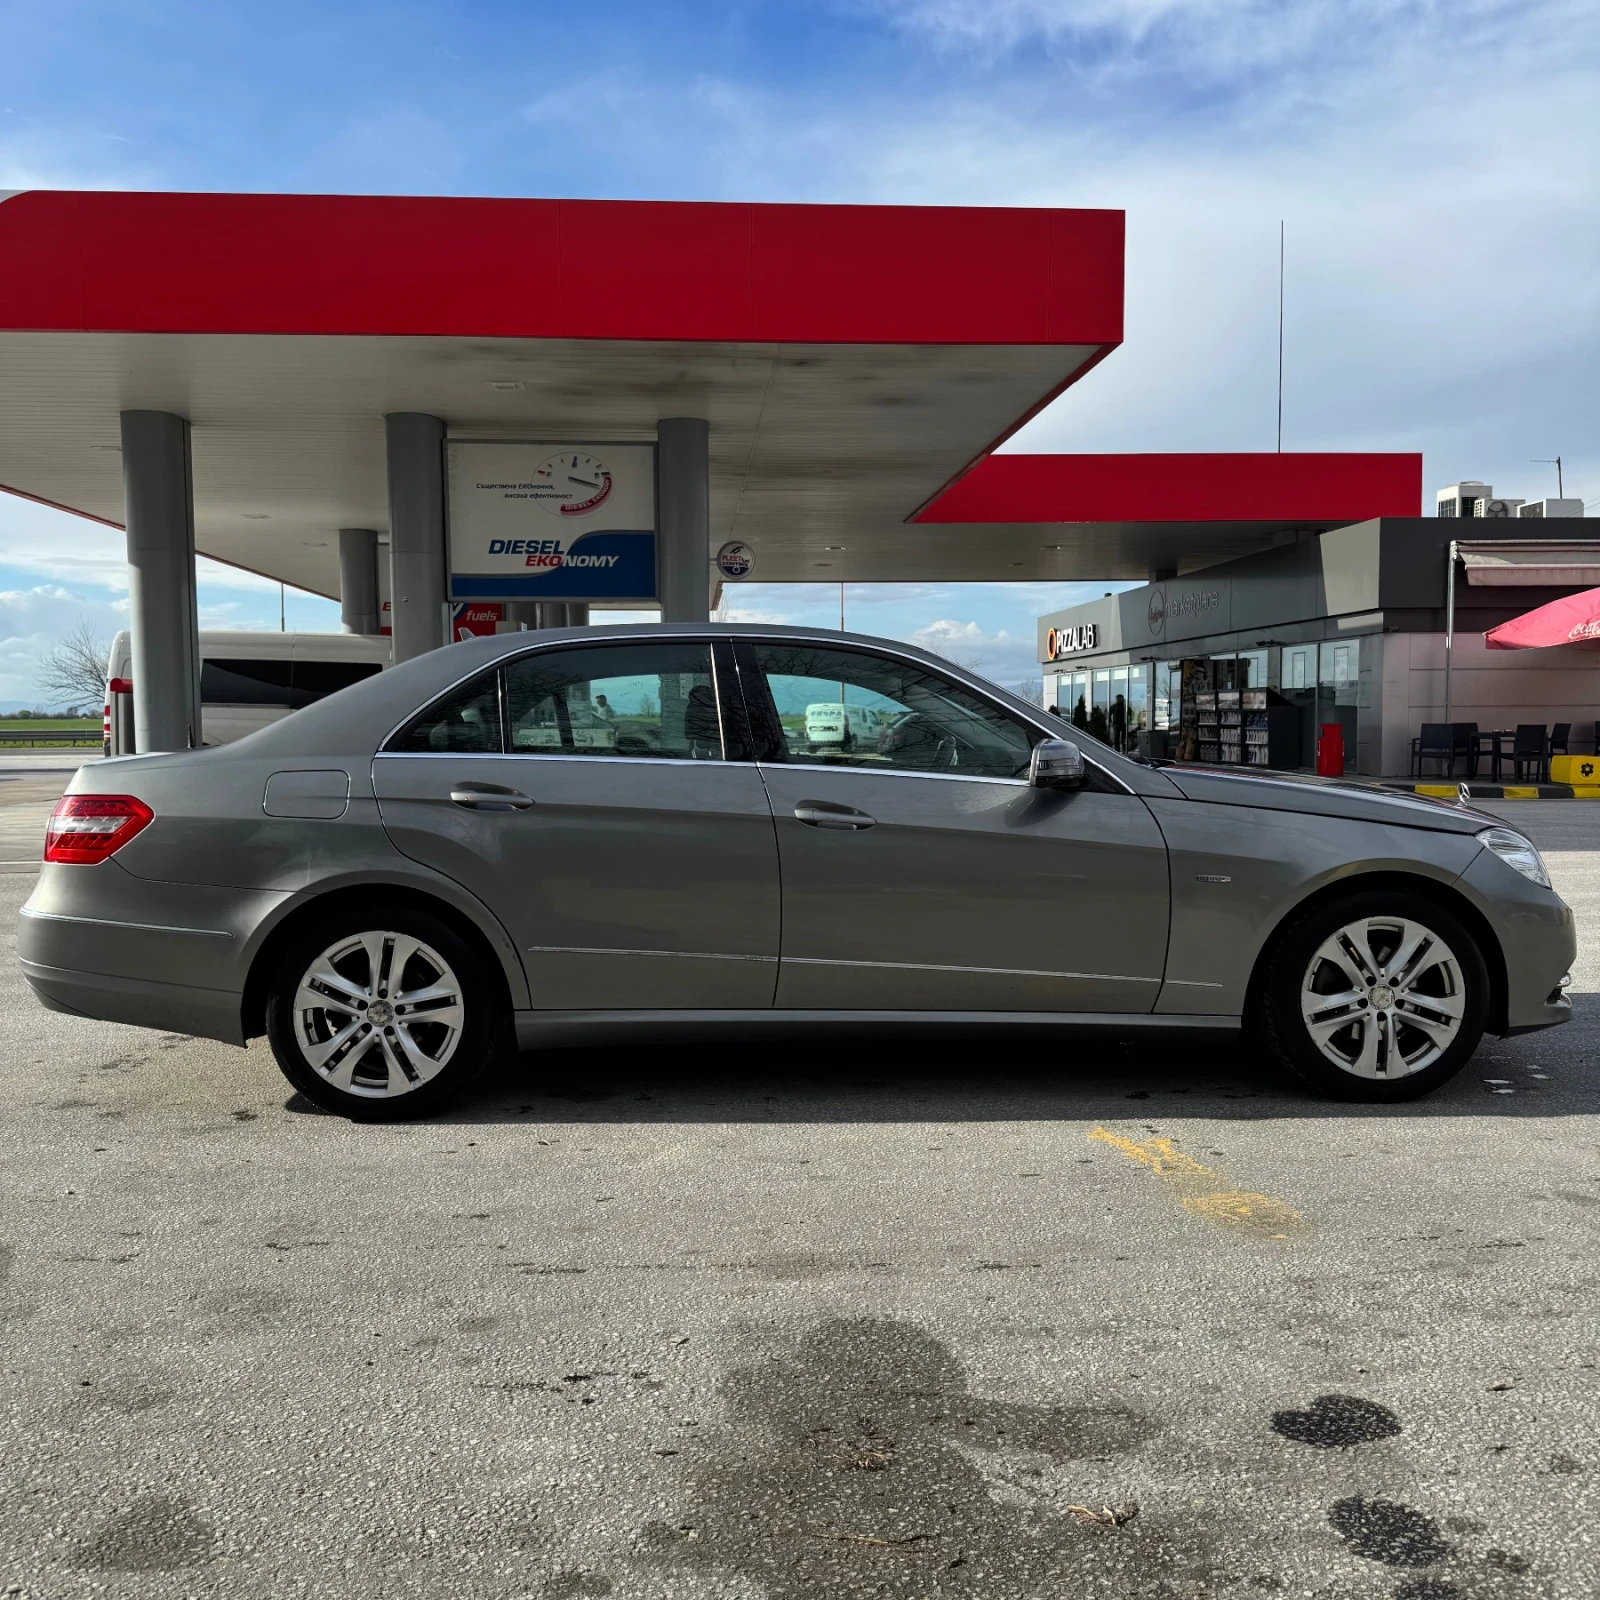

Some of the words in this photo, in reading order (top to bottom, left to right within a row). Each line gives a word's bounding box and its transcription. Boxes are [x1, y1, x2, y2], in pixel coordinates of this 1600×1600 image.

[476, 482, 517, 490] Съществена
[529, 492, 573, 500] ефективност
[565, 501, 593, 511] DIESEL
[488, 539, 565, 554] DIESEL
[525, 555, 620, 568] EKONOMY
[1165, 589, 1219, 618] marketplace
[466, 610, 498, 621] fuels
